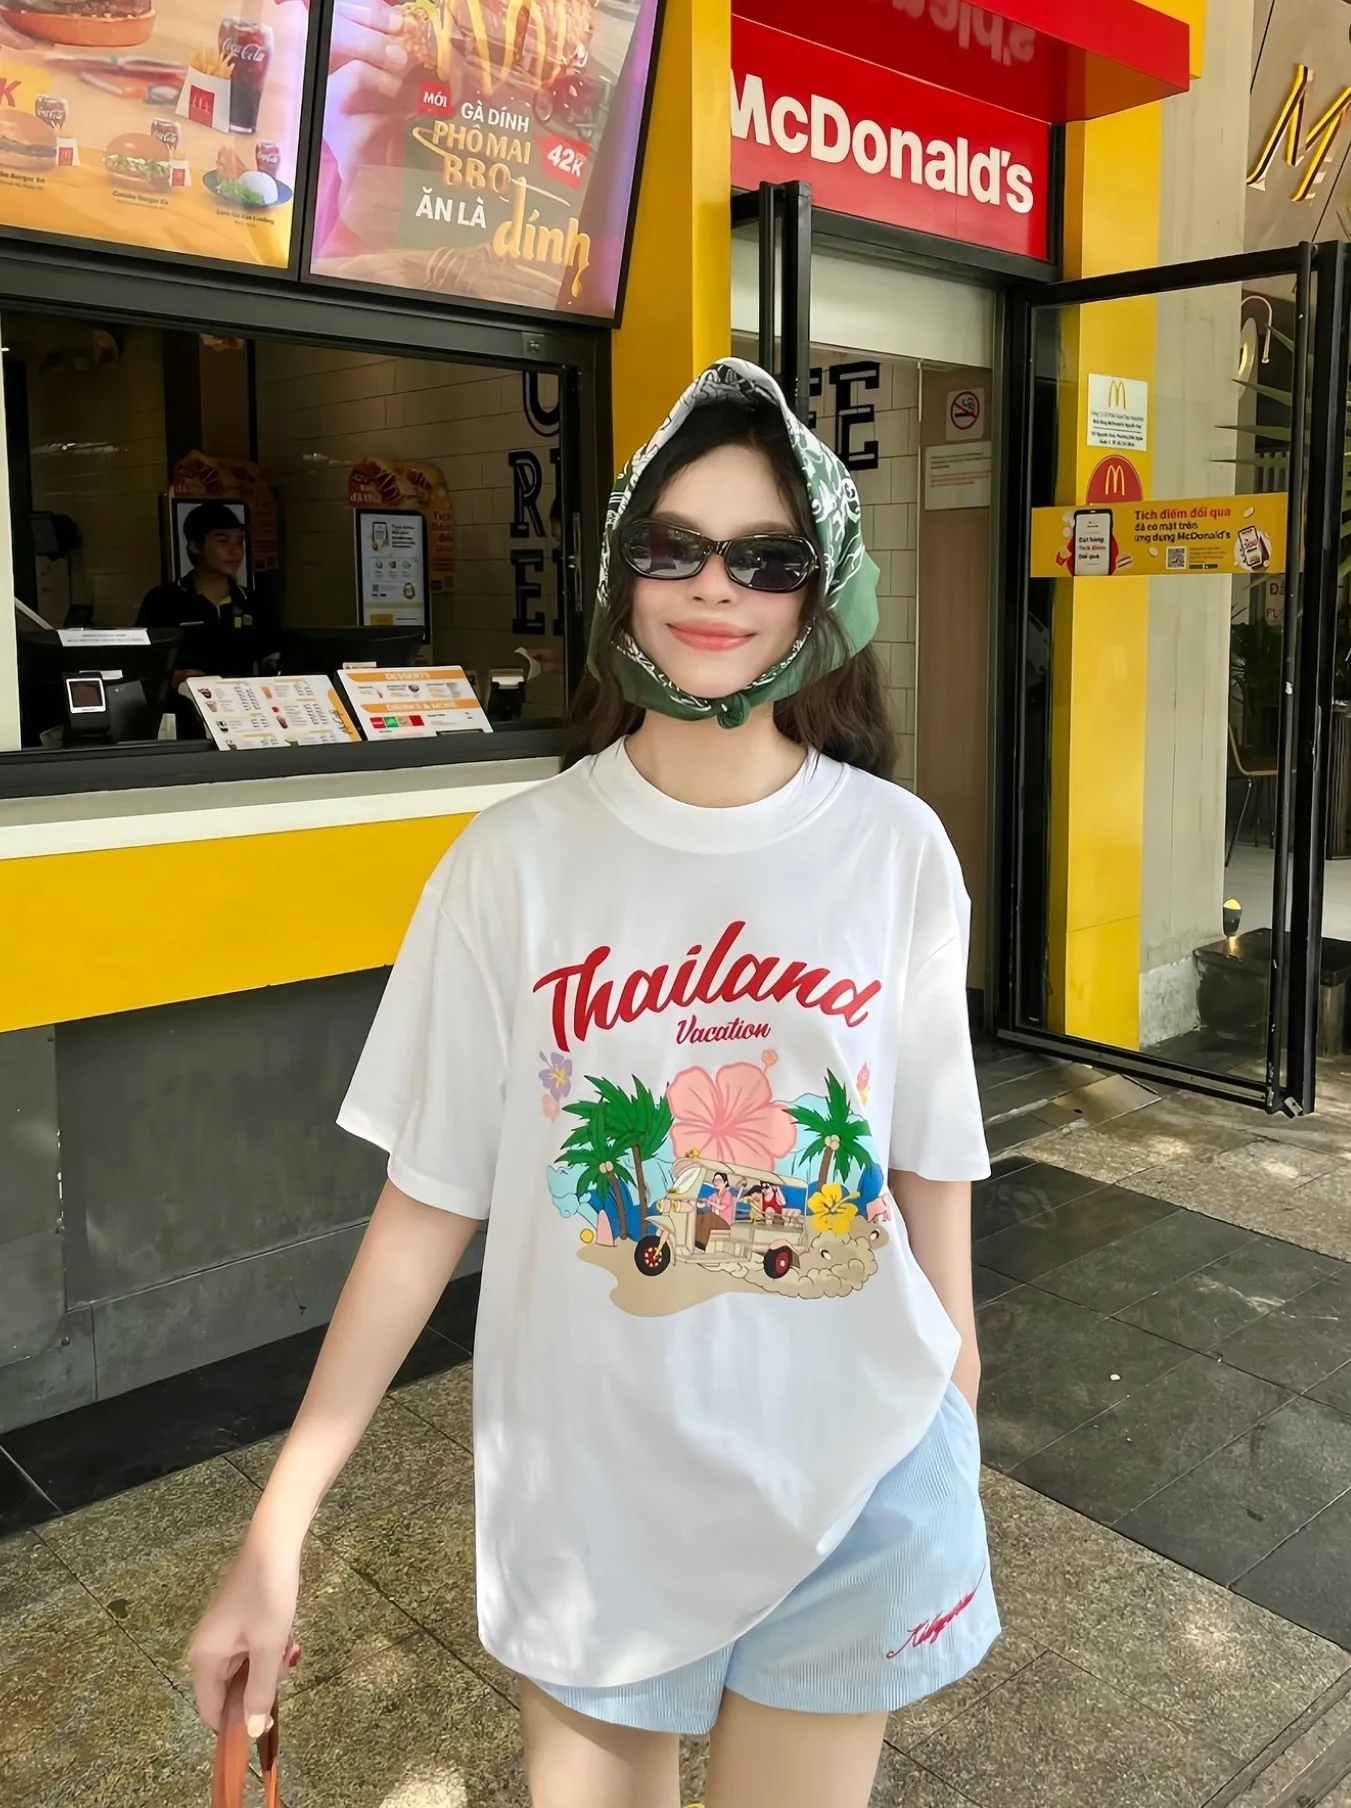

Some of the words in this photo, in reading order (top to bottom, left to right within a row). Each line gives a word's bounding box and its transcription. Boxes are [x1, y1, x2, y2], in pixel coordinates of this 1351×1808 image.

[423, 91, 447, 108] MỚI
[461, 100, 485, 122] GÀ
[488, 106, 530, 133] DÍNH
[432, 119, 483, 153] PHÔ
[486, 132, 531, 165] MAI
[547, 144, 585, 177] 42K
[731, 68, 1034, 214] McDonald's
[442, 153, 512, 200] BBQ
[415, 186, 453, 222] ĂN
[457, 196, 487, 229] LÀ
[492, 176, 592, 275] dính
[1177, 530, 1231, 541] McDonald's
[533, 921, 882, 1052] Thailand
[676, 1014, 772, 1045] Vacation
